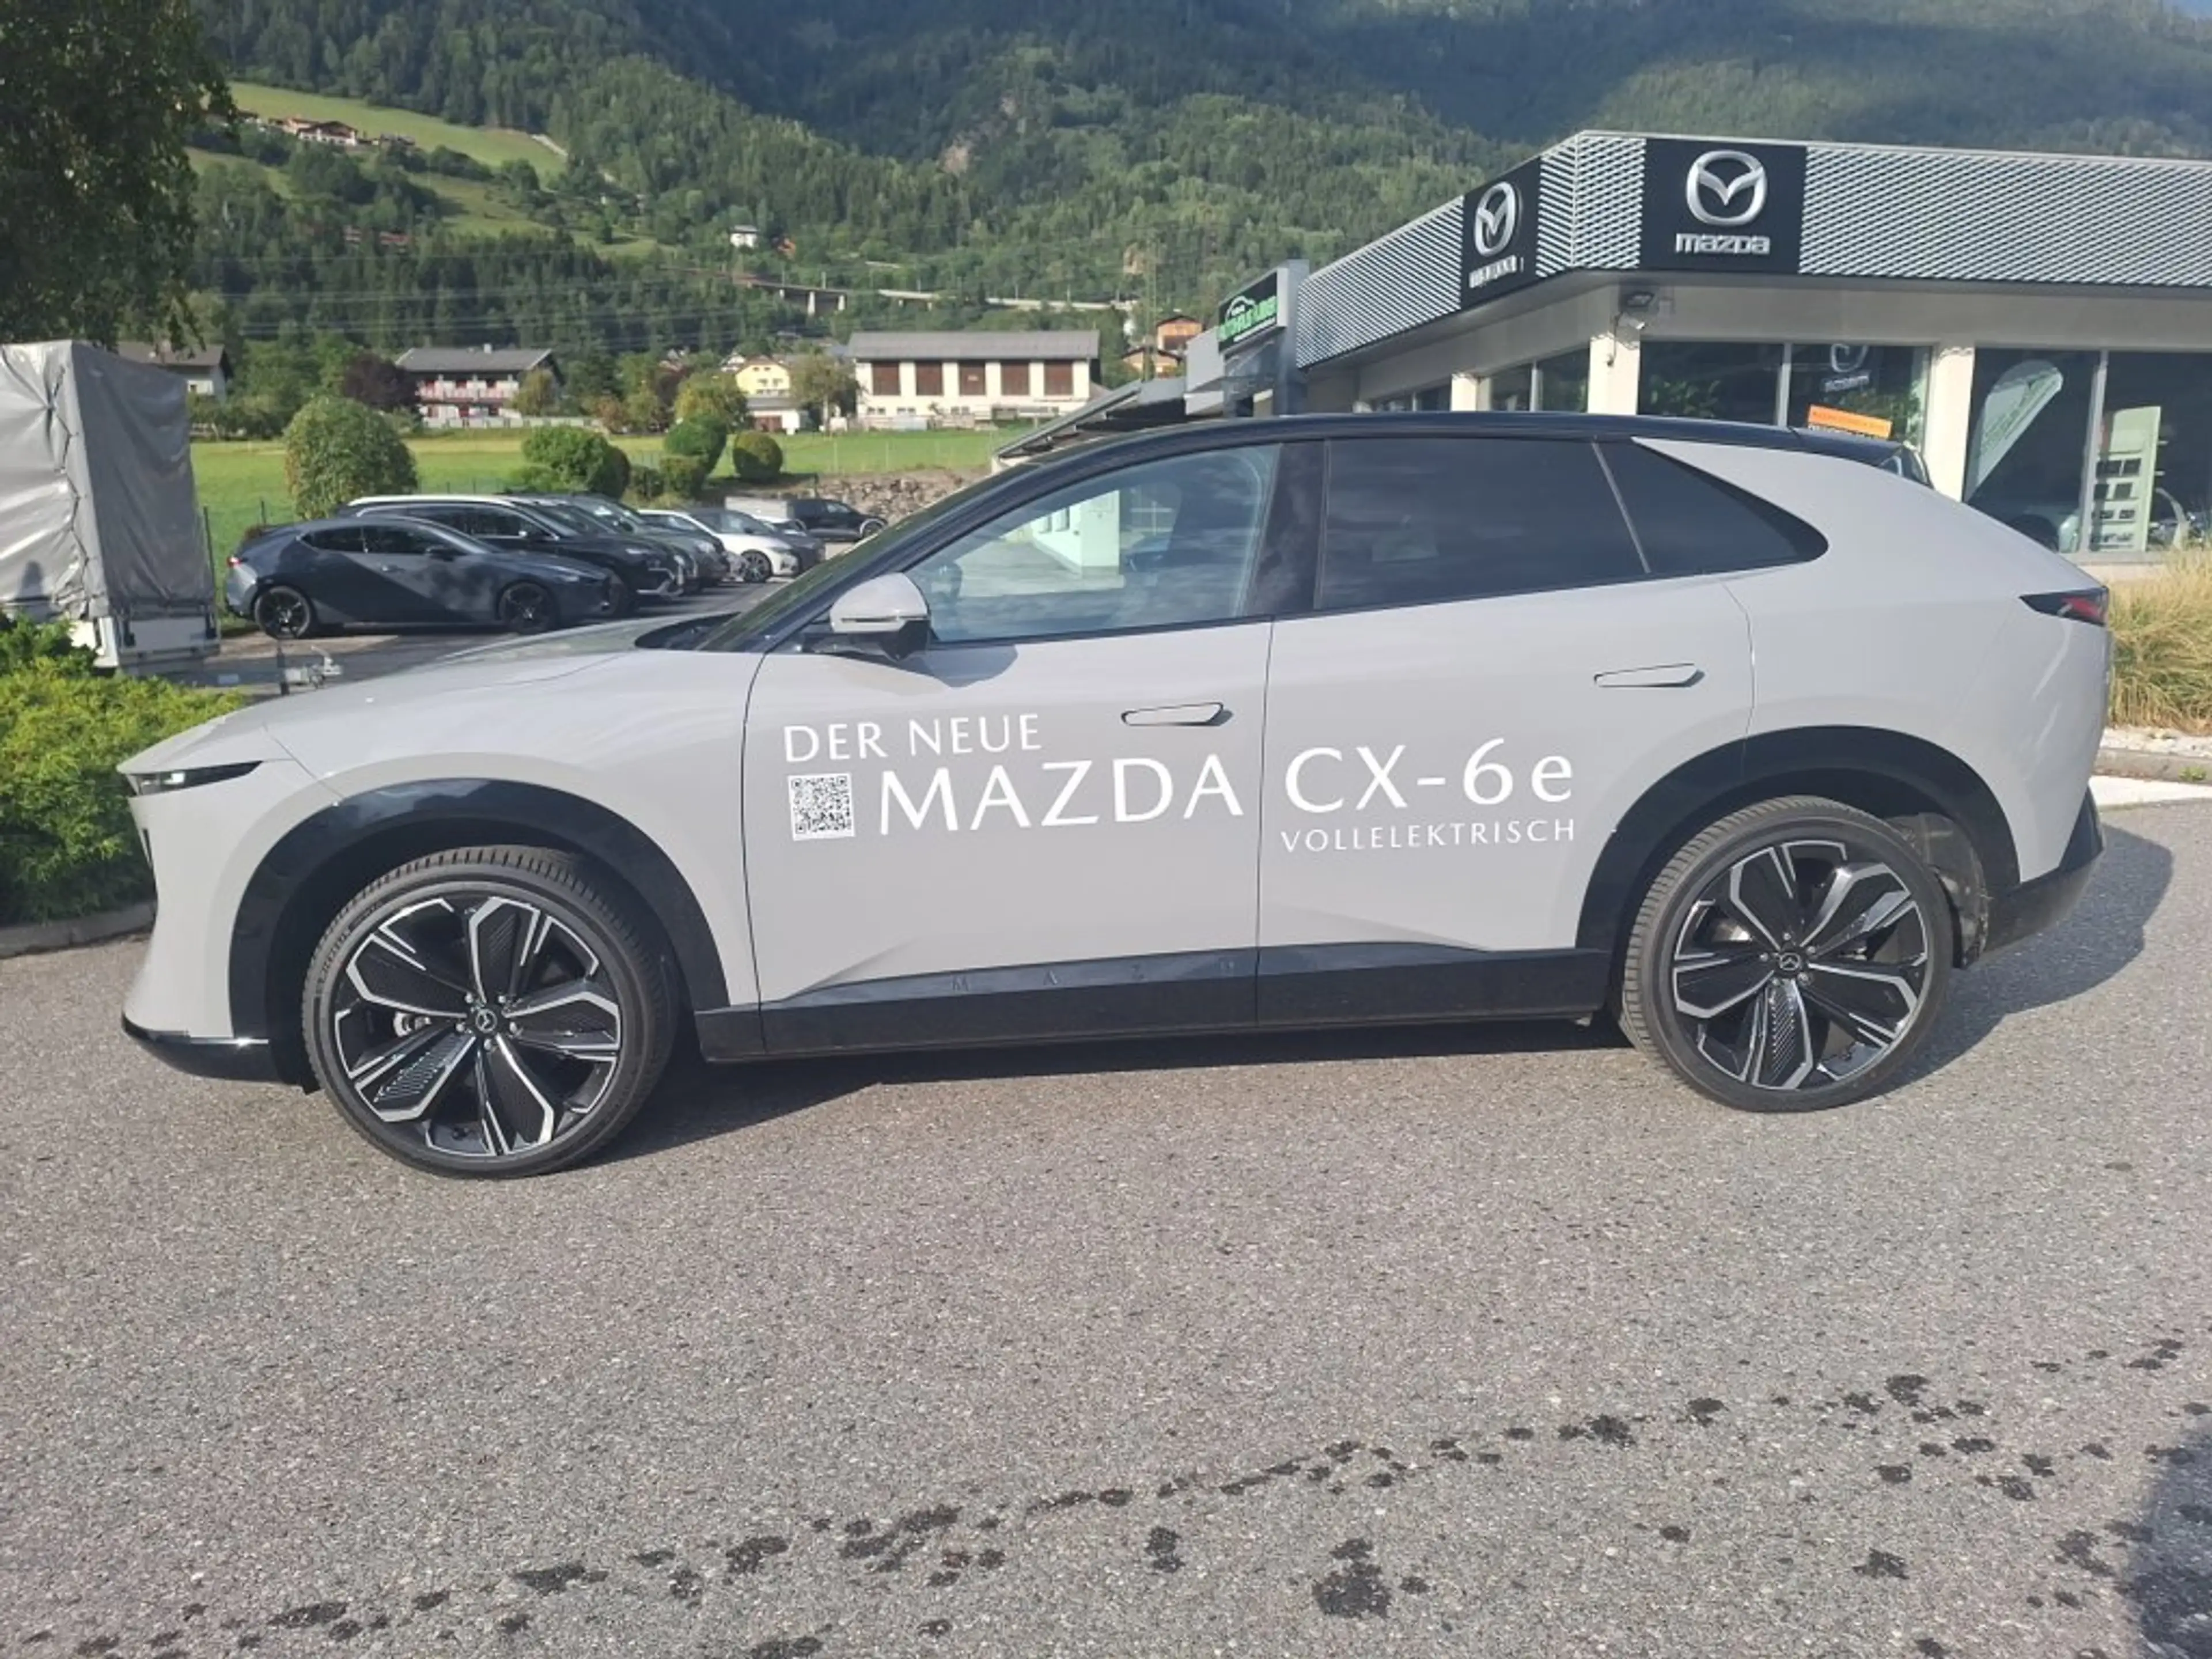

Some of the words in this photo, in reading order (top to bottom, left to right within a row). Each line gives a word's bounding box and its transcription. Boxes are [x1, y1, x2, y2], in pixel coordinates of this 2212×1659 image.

[783, 721, 888, 762] DER
[908, 713, 1042, 756] NEUE
[880, 753, 1244, 835] MAZDA
[1285, 738, 1573, 813] CX-6e
[1280, 819, 1575, 853] VOLLELEKTRISCH
